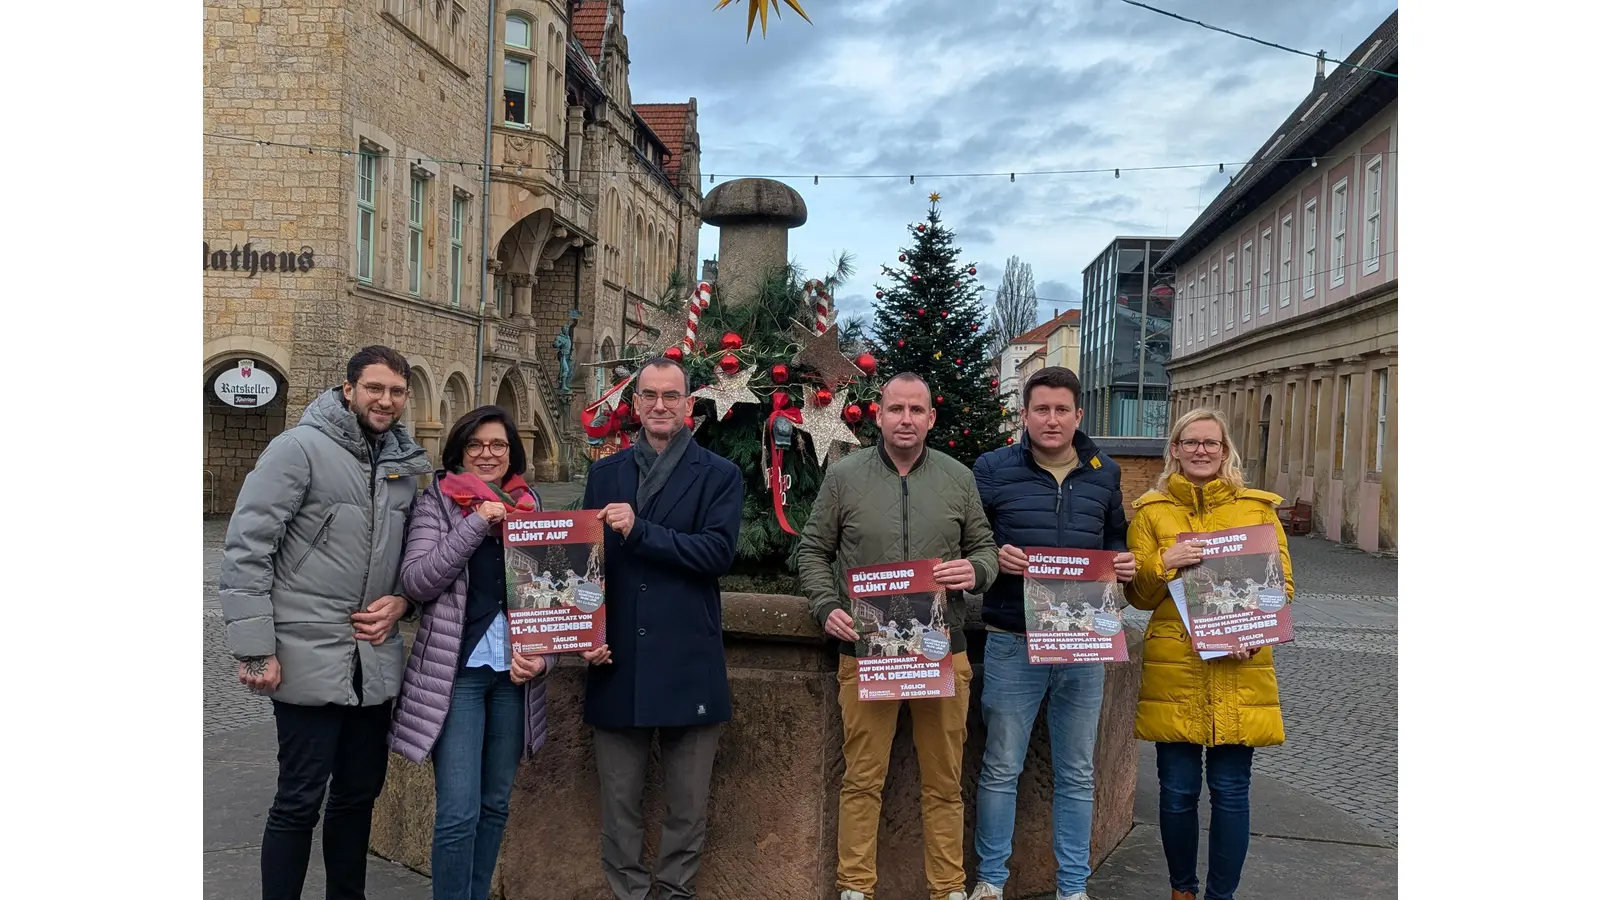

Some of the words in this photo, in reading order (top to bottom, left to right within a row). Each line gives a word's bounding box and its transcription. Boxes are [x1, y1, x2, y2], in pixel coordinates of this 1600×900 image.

[220, 382, 270, 394] Ratskeller
[508, 519, 573, 530] BÜCKEBURG
[508, 531, 544, 542] GLÜHT
[546, 531, 568, 540] AUF
[1185, 533, 1247, 546] KEBURG
[1222, 544, 1243, 552] AUF
[1029, 553, 1089, 565] BÜCKEBURG
[1028, 564, 1061, 574] GLÜHT
[1063, 567, 1083, 575] AUF
[852, 569, 914, 582] BÜCKEBURG
[853, 582, 887, 593] GLÜHT
[889, 581, 910, 590] AUF
[510, 609, 571, 617] WEIHNACHTSMARKT
[1193, 611, 1254, 623] WEIHNACHTSMARKT
[1221, 616, 1261, 626] MARKTPLATZ
[511, 625, 539, 635] 11.-14.
[540, 621, 592, 632] DEZEMBER
[1195, 629, 1223, 637] 11.-14.
[1224, 619, 1277, 634] DEZEMBER
[552, 635, 577, 643] TÄGLICH
[1238, 633, 1264, 642] TÄGLICH
[1059, 642, 1112, 650] DEZEMBER
[859, 657, 917, 665] WEIHNACHTSMARKT
[859, 672, 887, 681] 11.-14.
[888, 669, 940, 680] DEZEMBER
